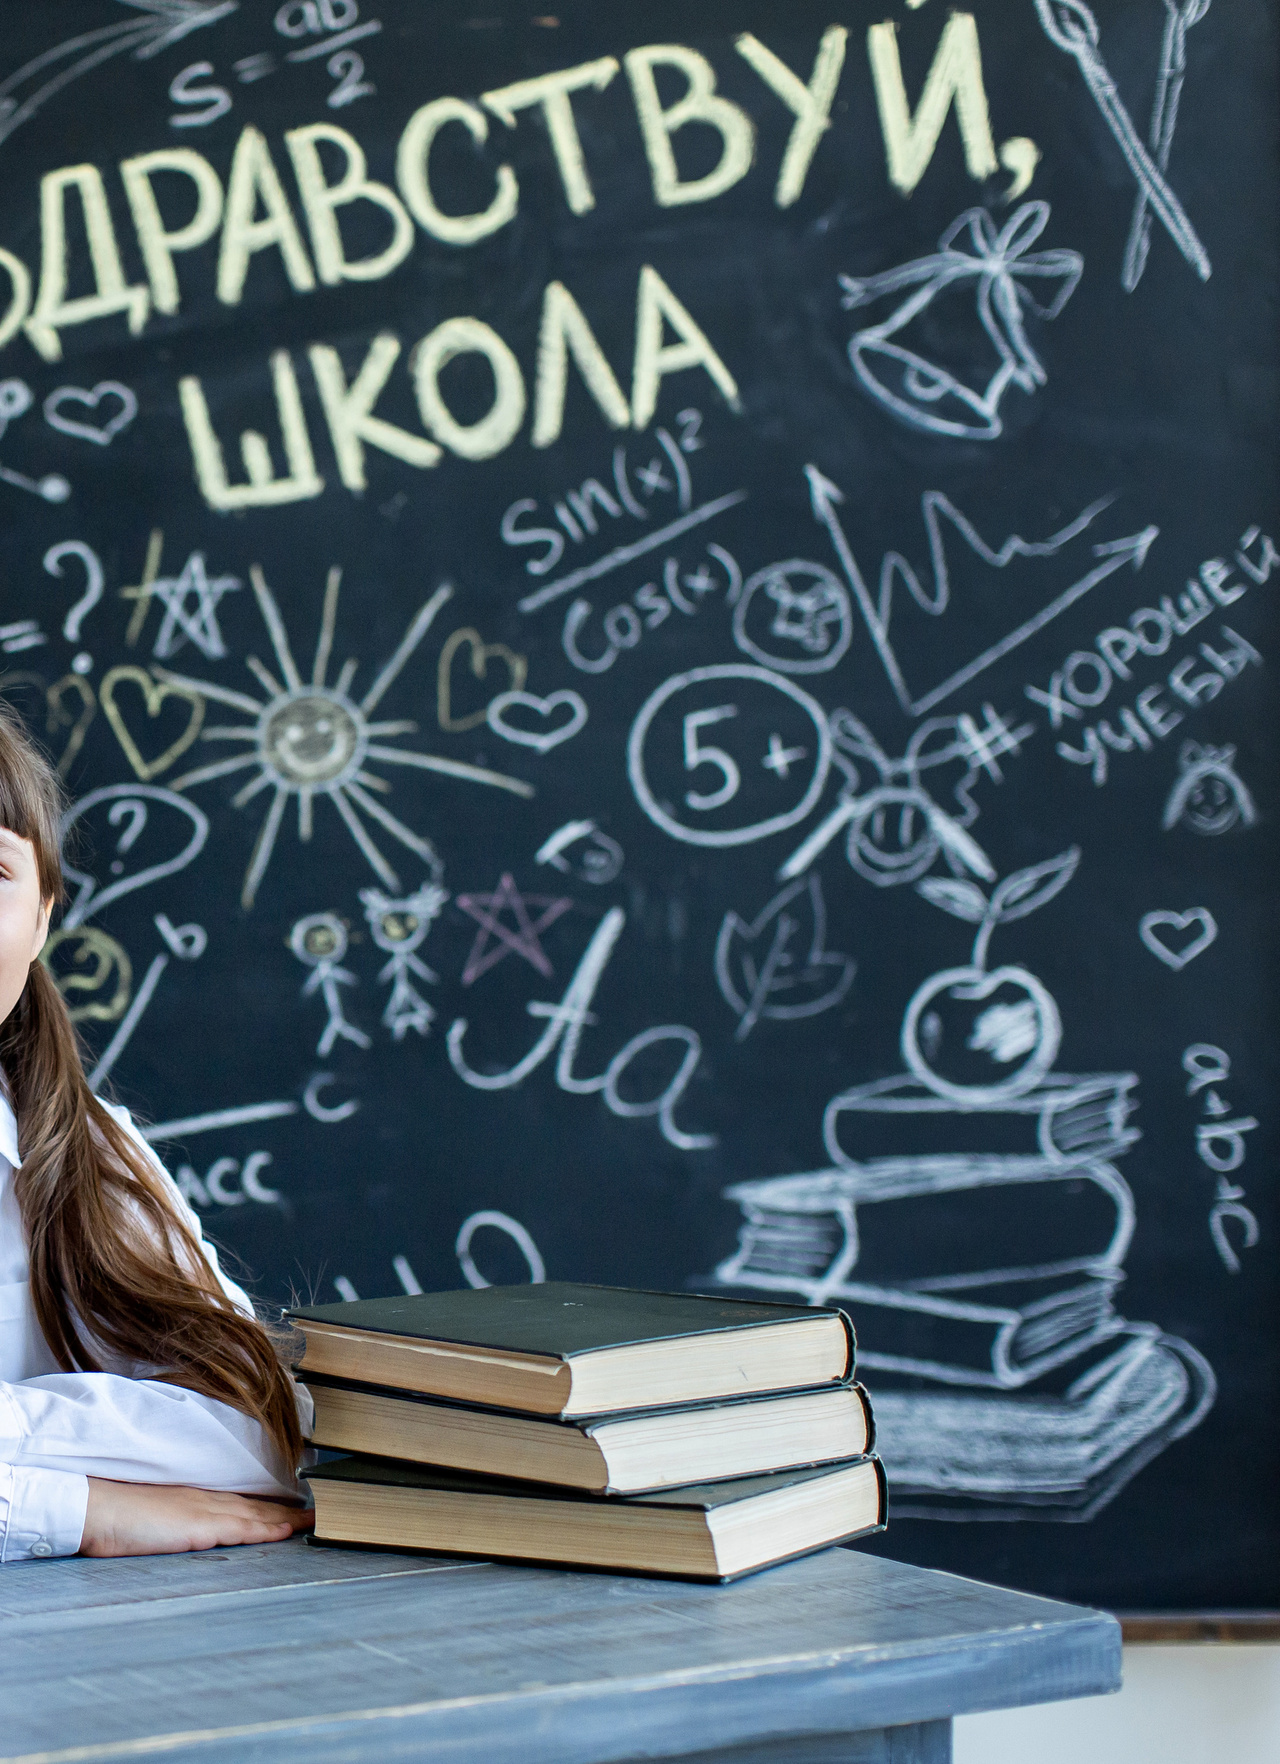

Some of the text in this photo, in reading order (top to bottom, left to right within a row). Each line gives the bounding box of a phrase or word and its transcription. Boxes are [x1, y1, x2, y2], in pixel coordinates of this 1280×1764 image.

[326, 50, 377, 108] 2
[178, 264, 744, 512] ШКОЛА
[1055, 623, 1265, 788] УЧЕБЫ
